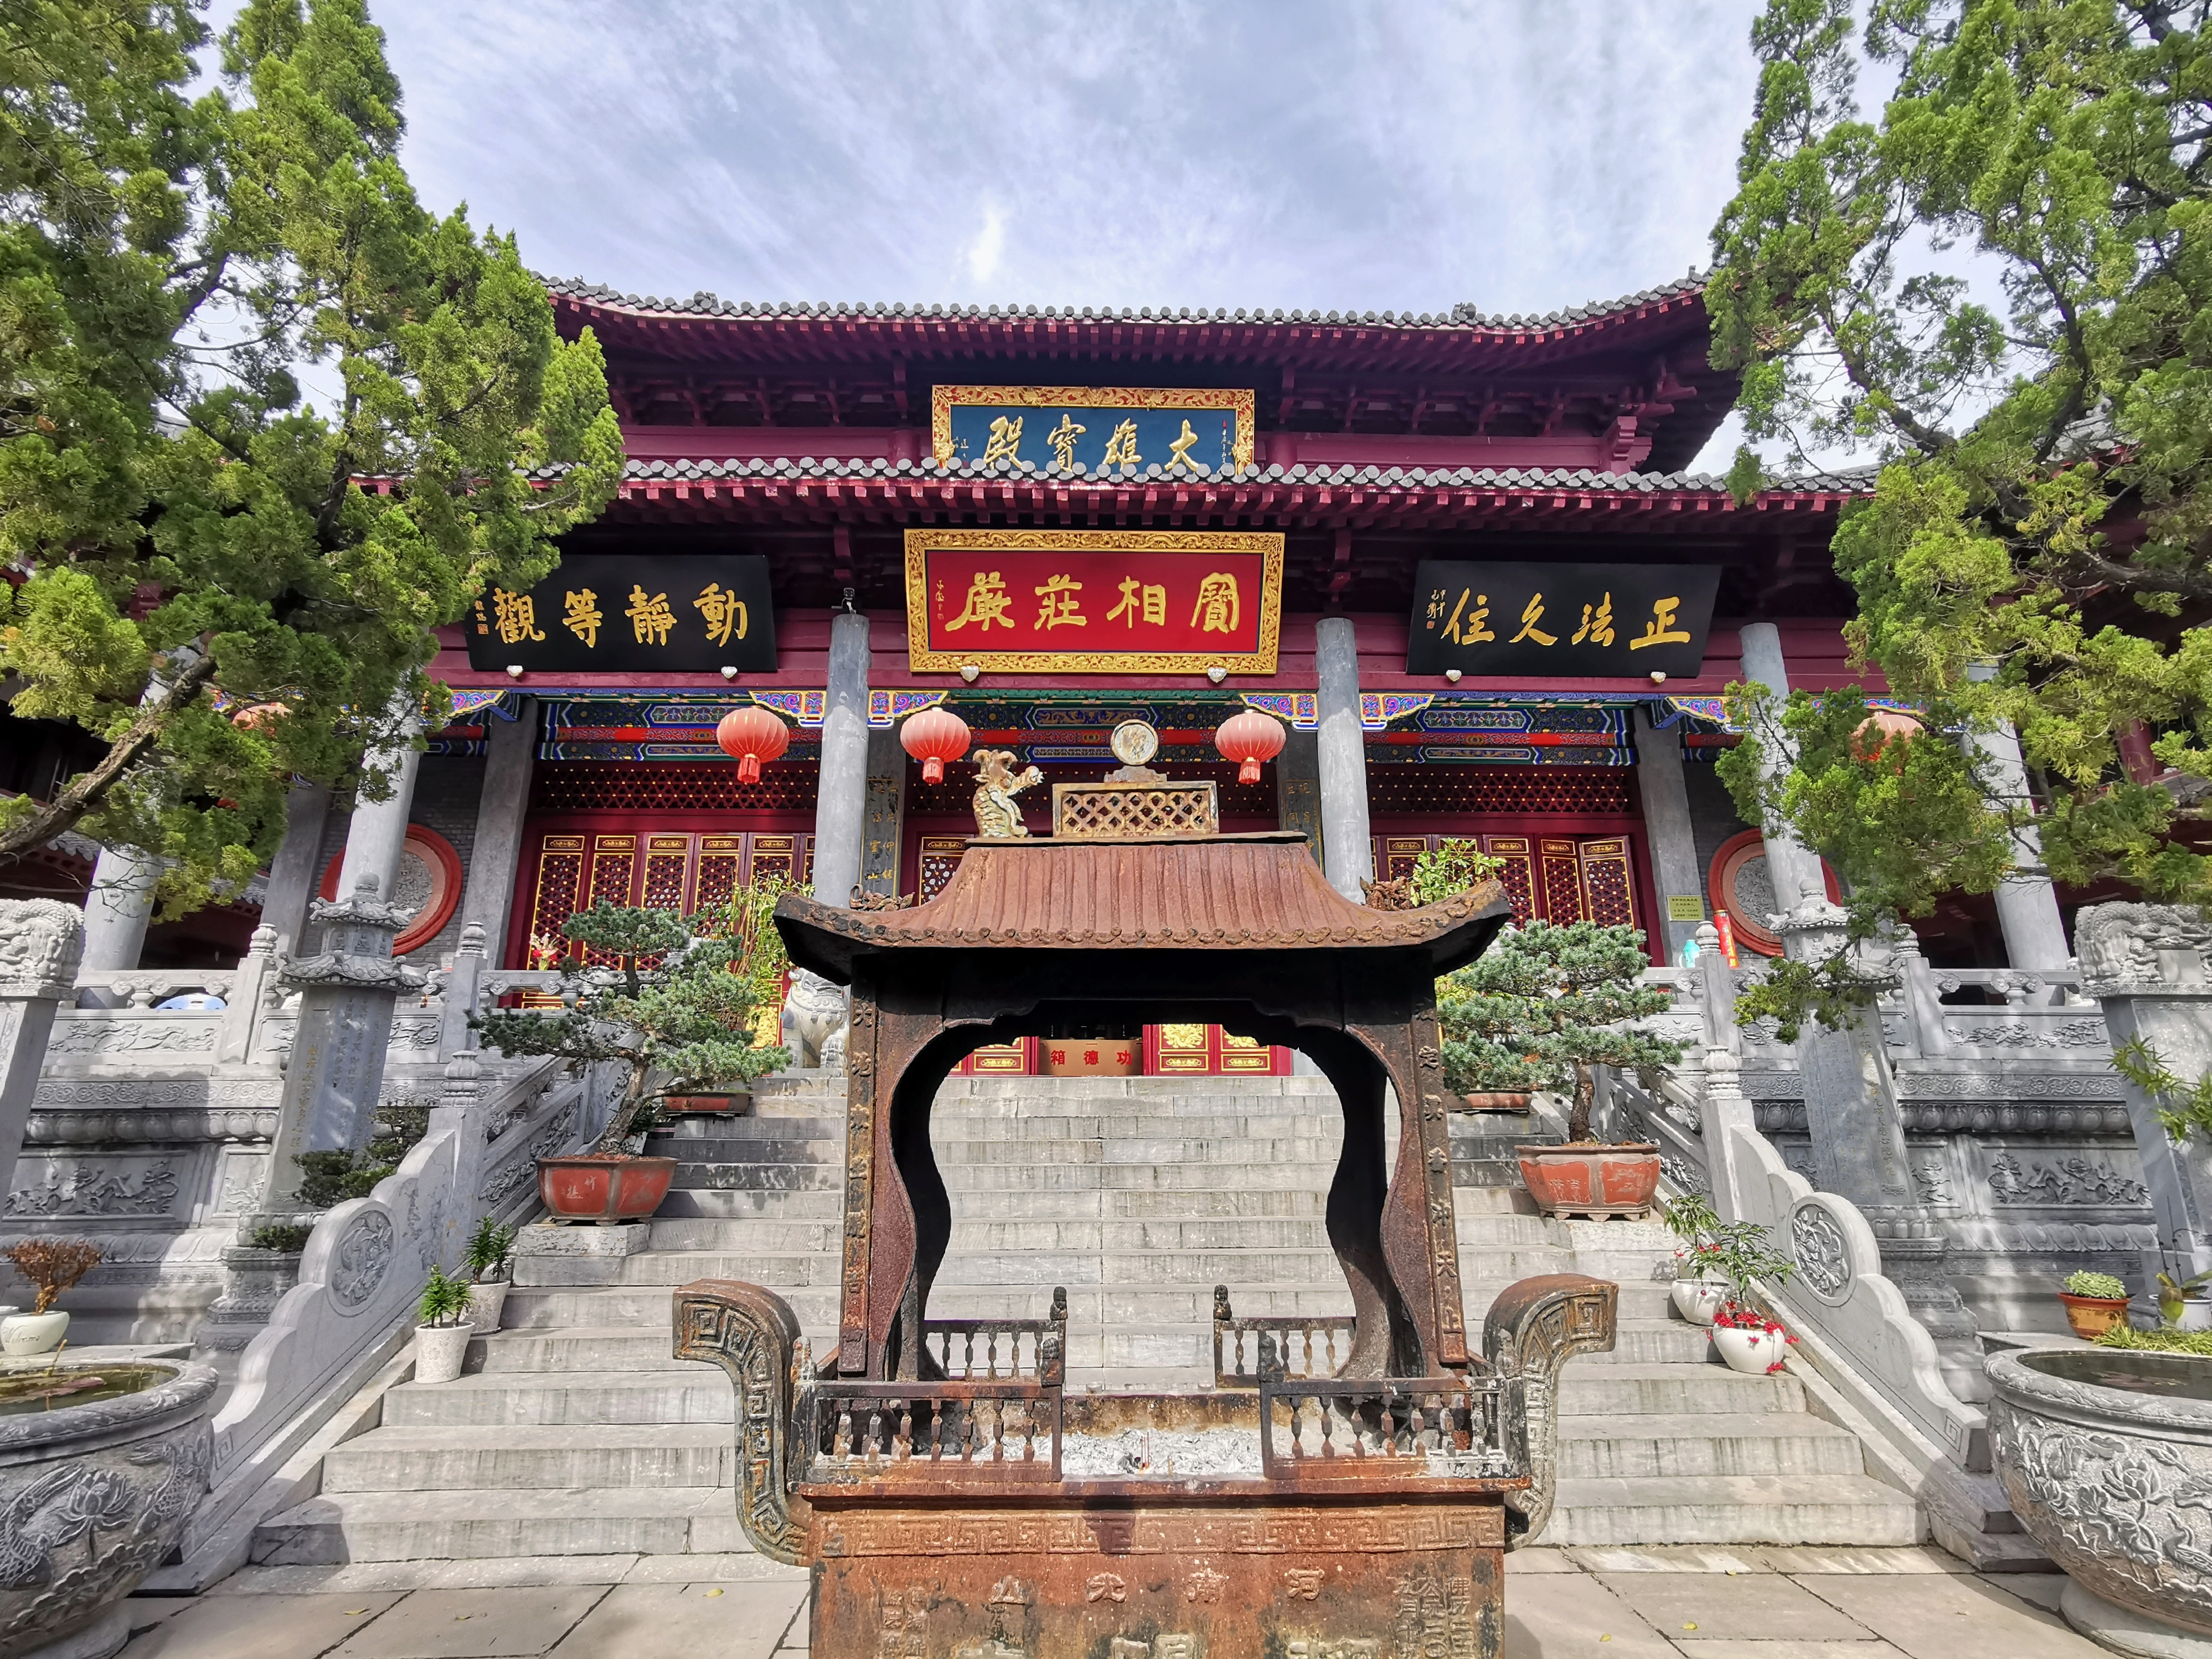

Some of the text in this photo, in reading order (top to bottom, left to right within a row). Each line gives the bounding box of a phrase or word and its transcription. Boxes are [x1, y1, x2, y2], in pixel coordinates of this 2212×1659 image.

[493, 583, 748, 648] 動靜等觀
[945, 571, 1240, 633] 寶相莊嚴
[1441, 587, 1692, 650] 正法久住
[1051, 1049, 1132, 1065] 功德箱
